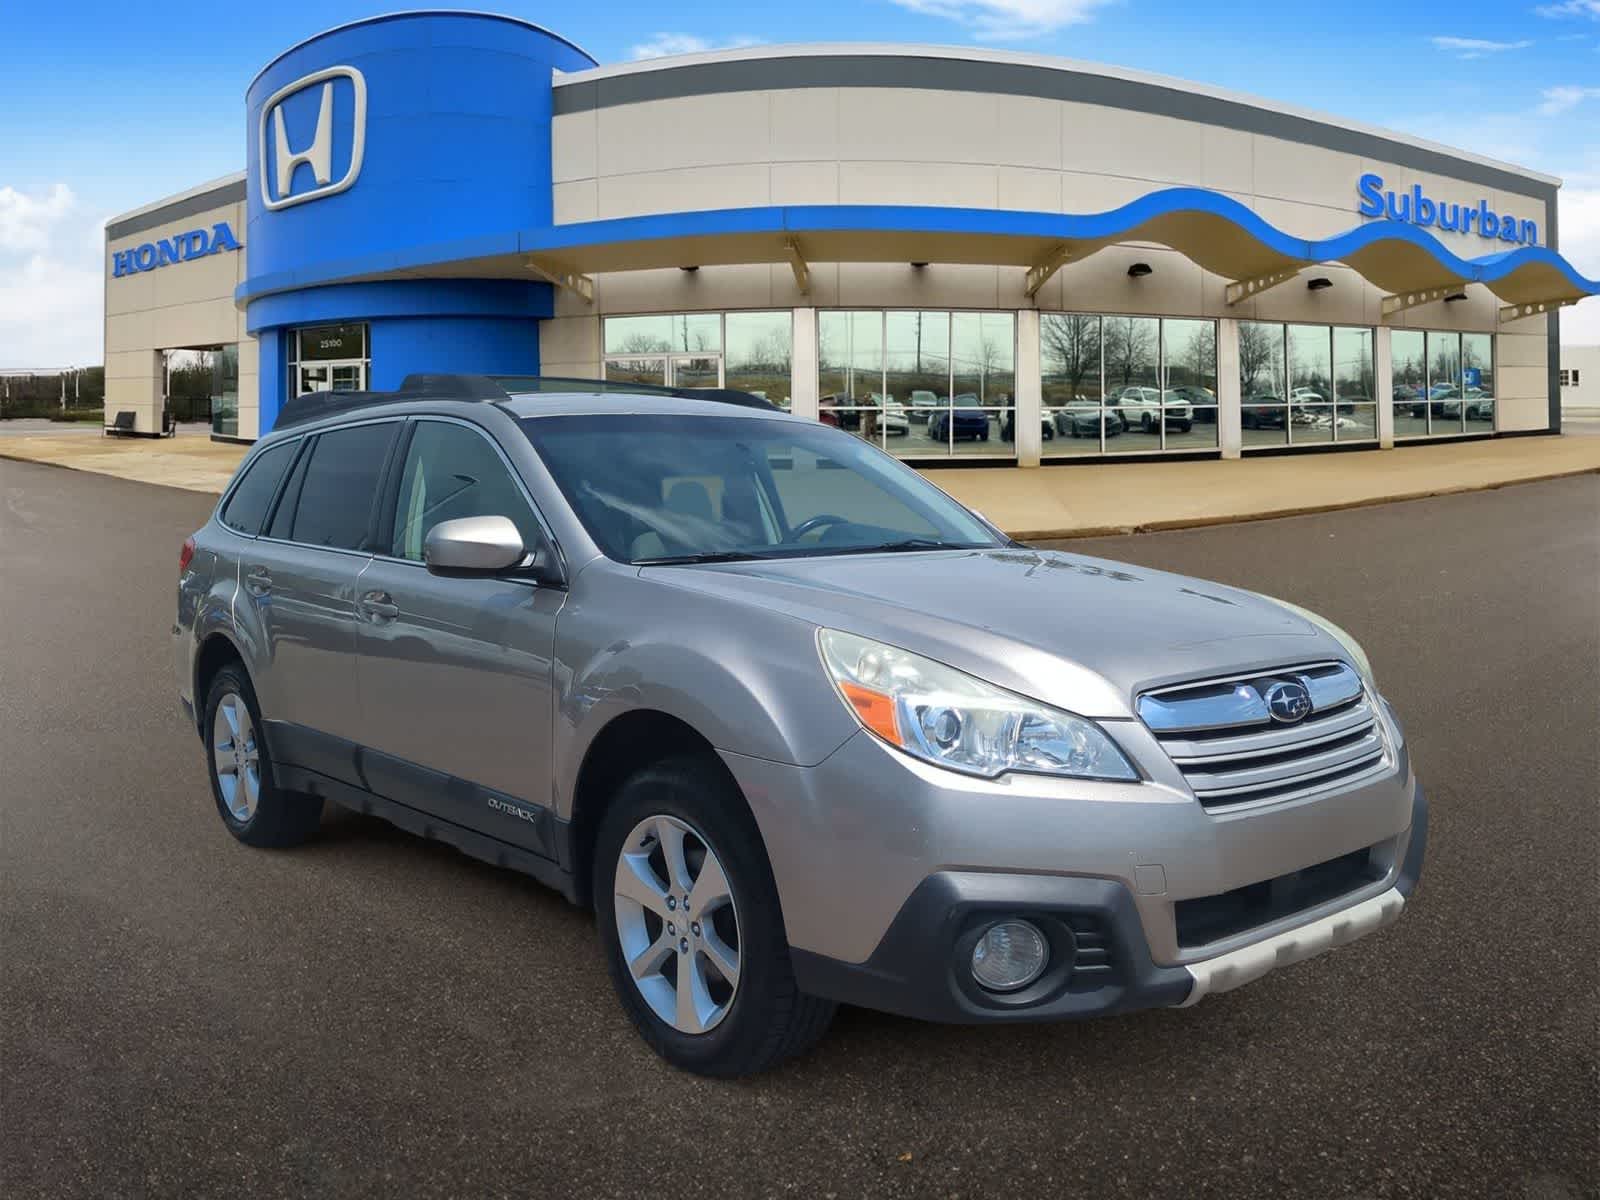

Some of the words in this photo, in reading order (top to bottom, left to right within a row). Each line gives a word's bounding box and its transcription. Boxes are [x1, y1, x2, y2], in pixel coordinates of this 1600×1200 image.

[1358, 174, 1538, 246] Suburban
[112, 221, 241, 278] HONDA
[488, 799, 535, 824] OUTBACK
